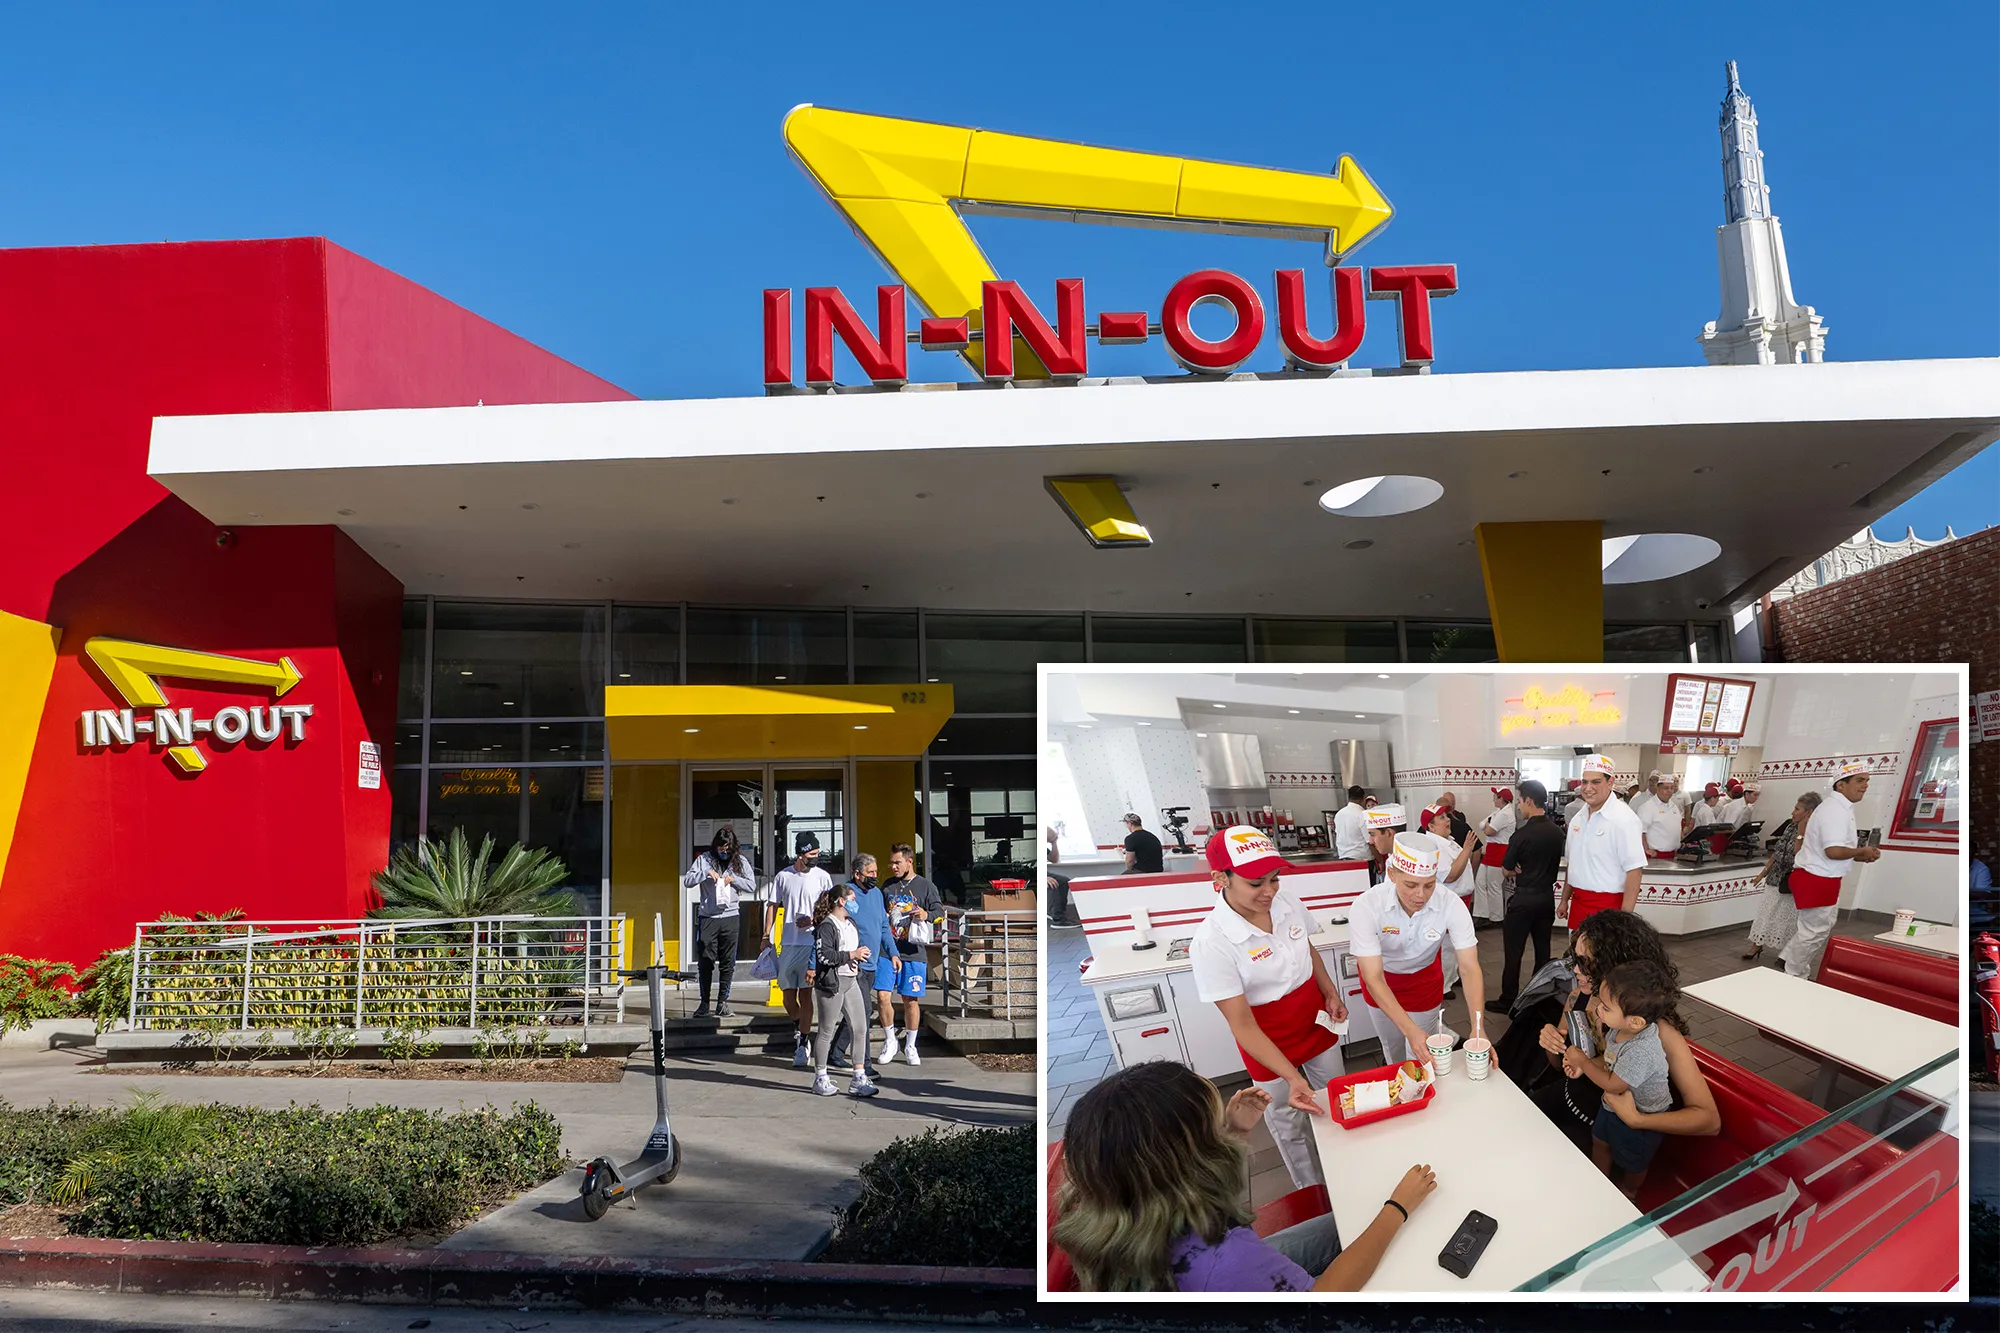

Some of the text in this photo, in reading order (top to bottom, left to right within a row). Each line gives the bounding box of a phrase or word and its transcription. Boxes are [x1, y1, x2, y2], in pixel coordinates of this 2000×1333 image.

[762, 263, 1459, 387] IN-N-OUT
[901, 691, 926, 704] 922
[1523, 683, 1592, 709] Quality
[1990, 693, 1999, 703] NO
[81, 704, 313, 746] IN-N-OUT
[1501, 703, 1621, 735] you can taste
[460, 768, 518, 784] Quality
[440, 780, 540, 799] you can tate
